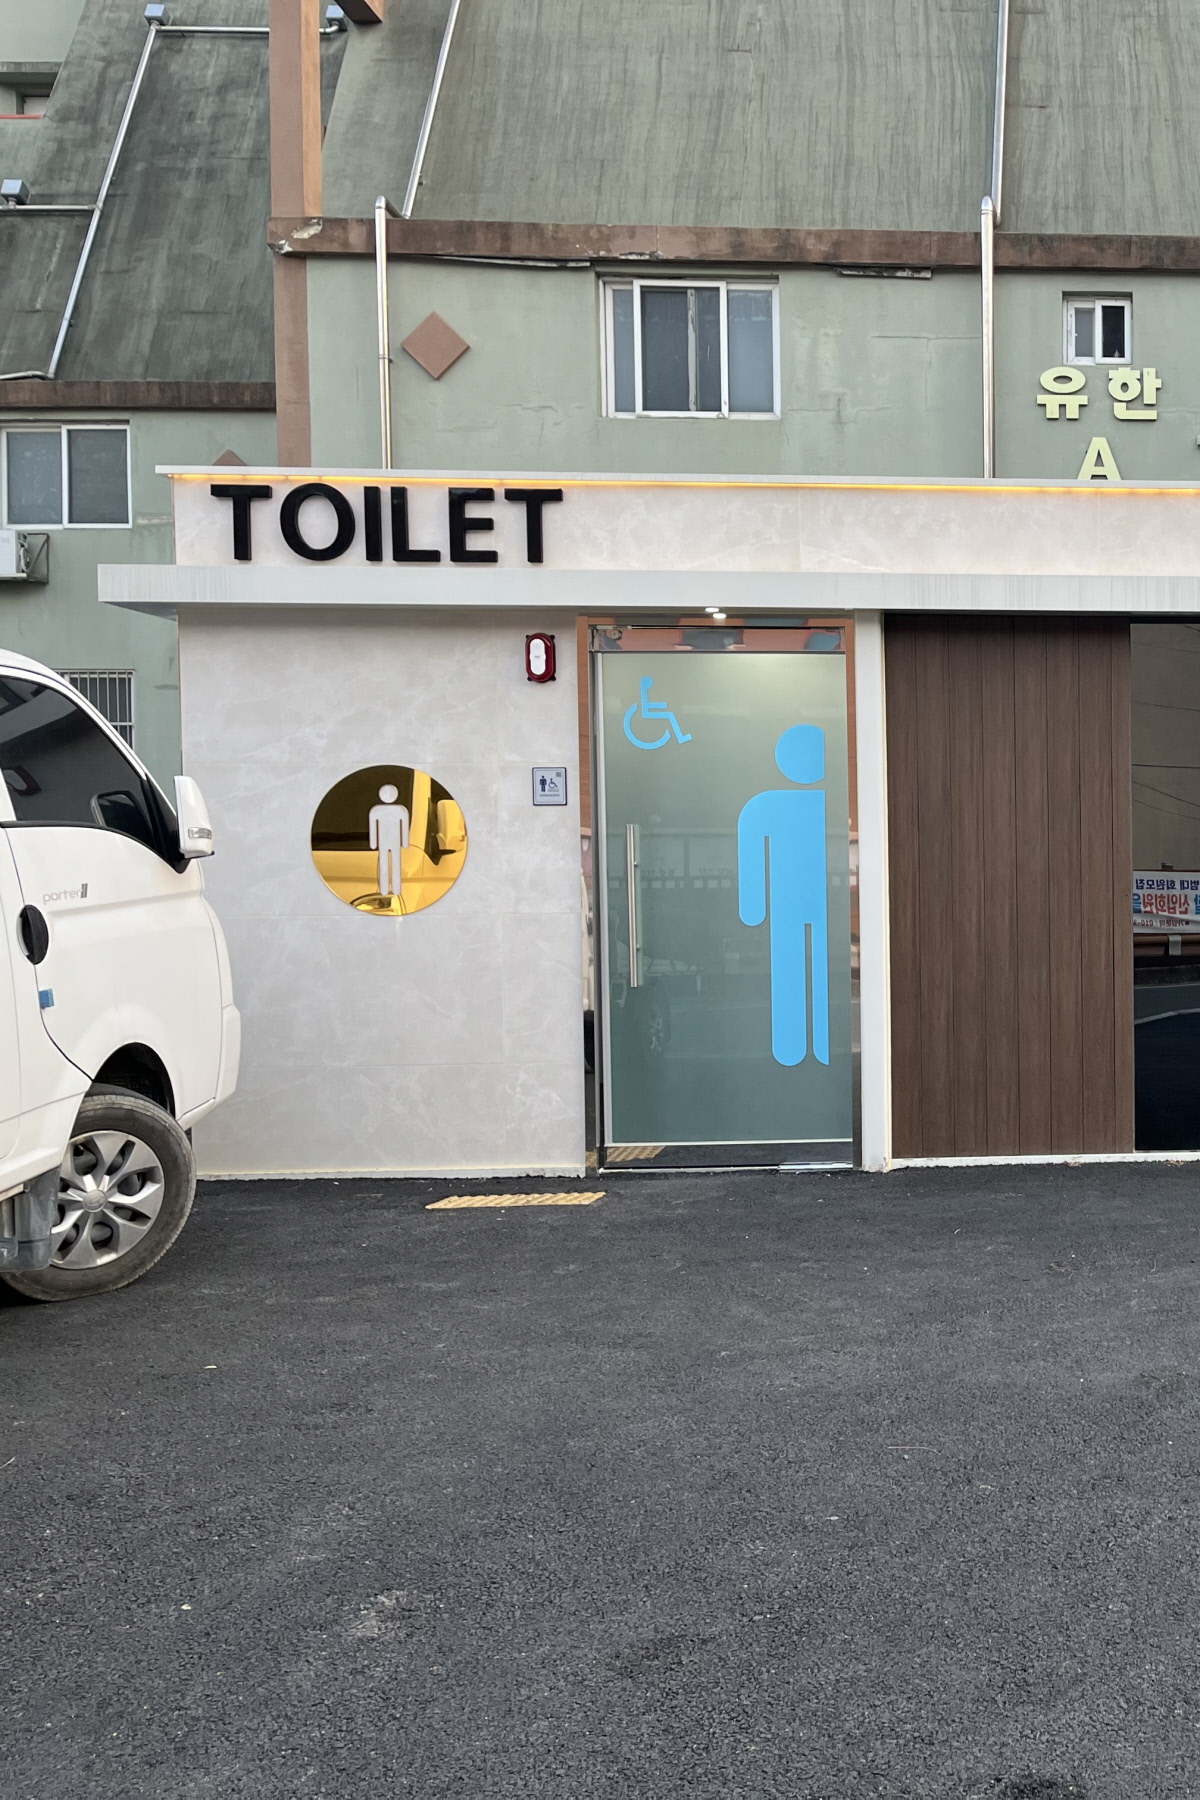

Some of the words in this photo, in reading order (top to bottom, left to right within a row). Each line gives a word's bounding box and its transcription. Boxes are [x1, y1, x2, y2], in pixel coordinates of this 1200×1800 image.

[1036, 366, 1163, 421] 유한
[1077, 437, 1122, 480] A
[210, 482, 564, 564] TOILET
